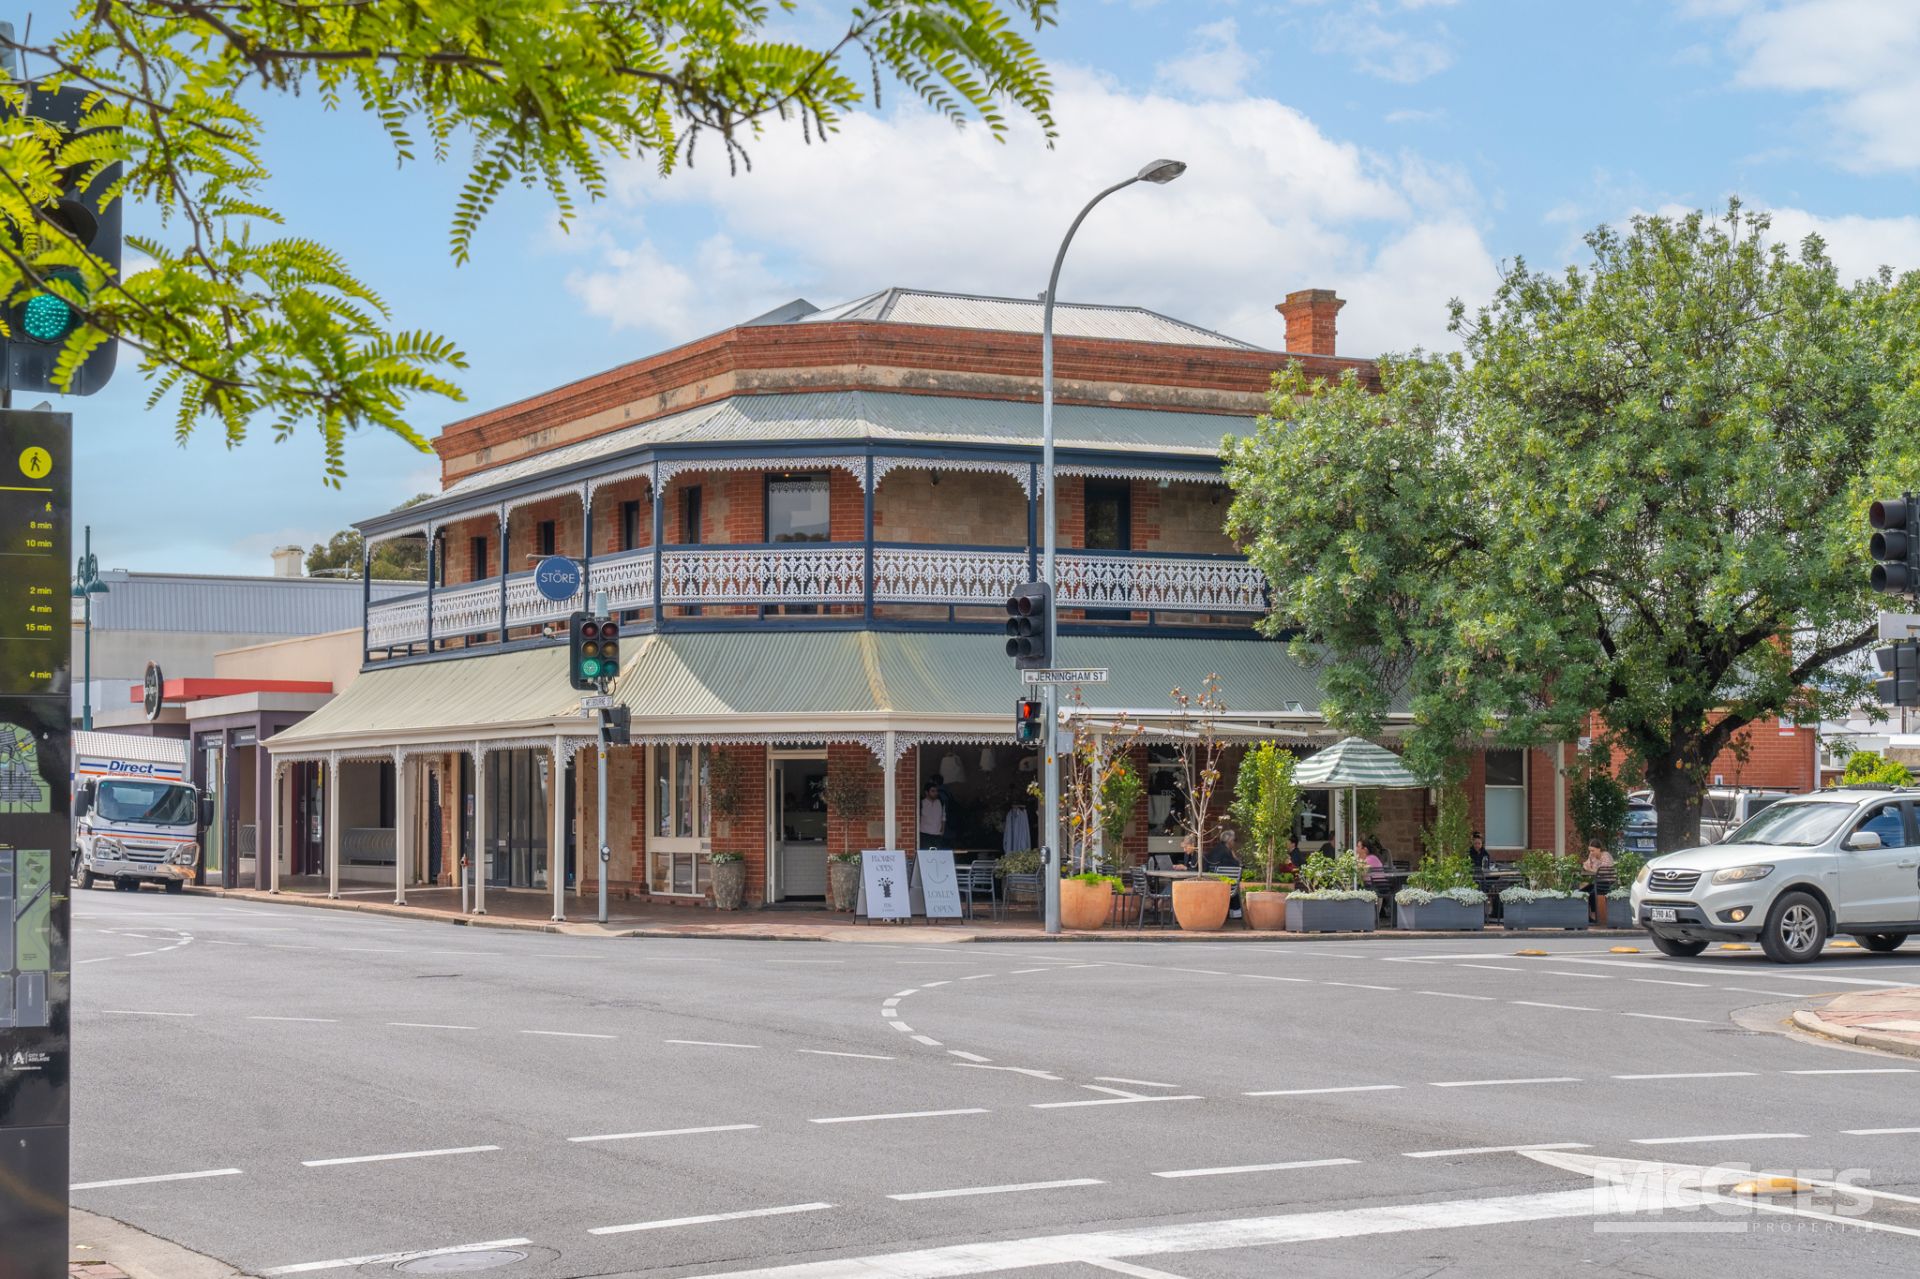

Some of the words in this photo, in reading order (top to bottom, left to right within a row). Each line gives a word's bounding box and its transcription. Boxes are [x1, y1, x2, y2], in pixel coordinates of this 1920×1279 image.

[37, 521, 52, 529] min
[26, 539, 36, 548] 10
[37, 539, 52, 548] min
[37, 586, 52, 595] min
[37, 605, 52, 613] min
[25, 623, 36, 631] 15
[37, 623, 52, 631] min
[37, 671, 52, 679] min
[1035, 672, 1091, 682] JERNINGHAM
[1093, 672, 1104, 681] ST
[109, 760, 154, 774] Direct
